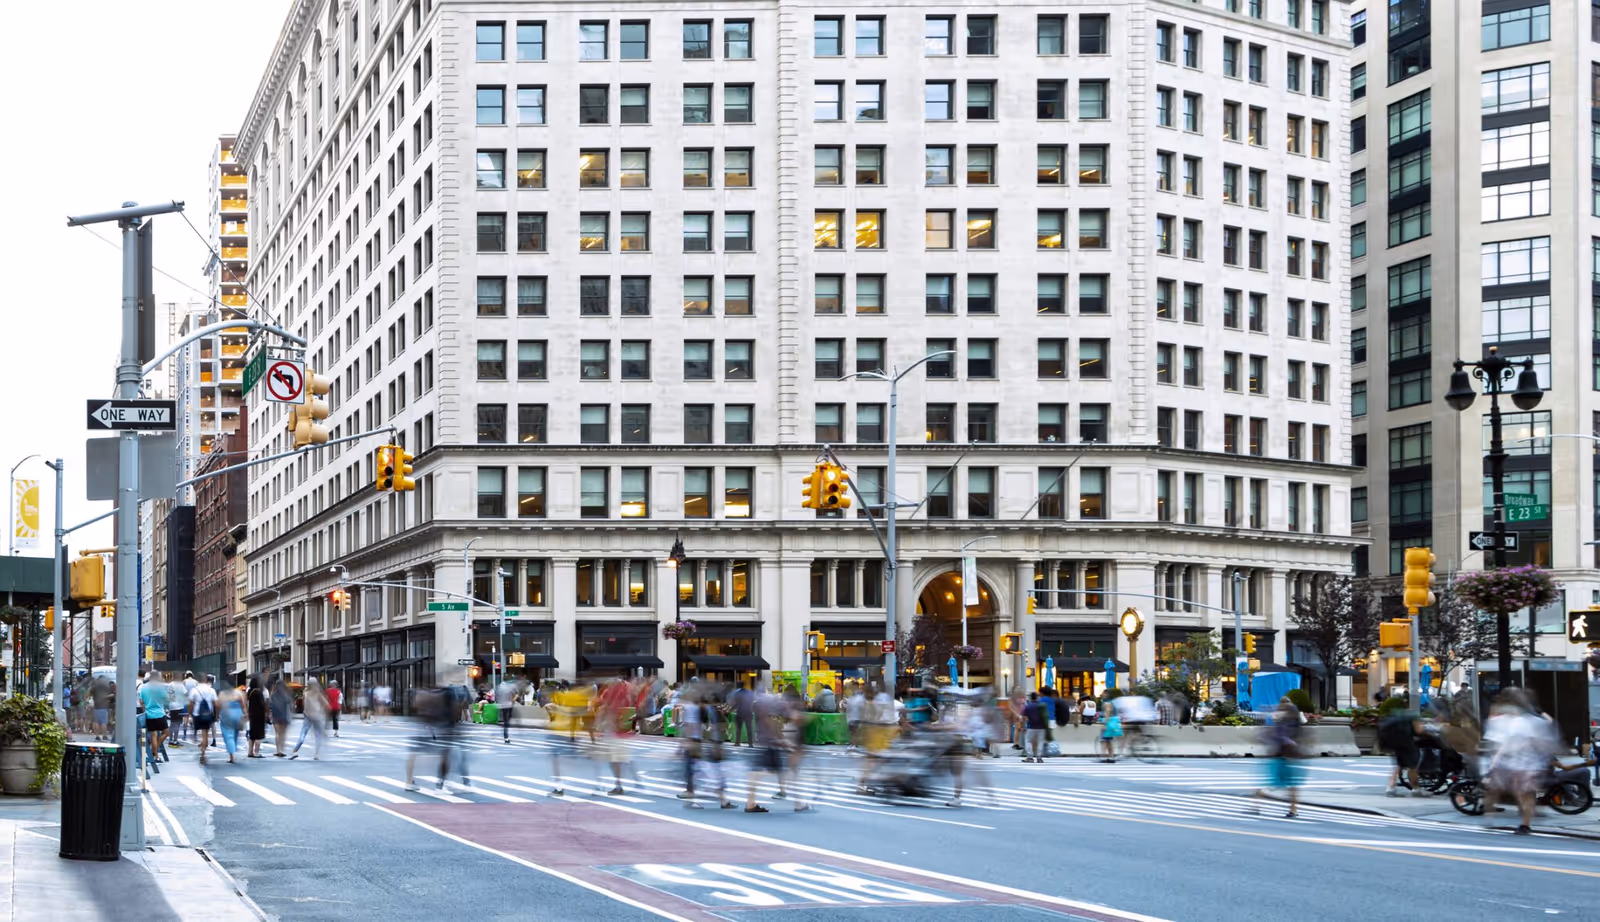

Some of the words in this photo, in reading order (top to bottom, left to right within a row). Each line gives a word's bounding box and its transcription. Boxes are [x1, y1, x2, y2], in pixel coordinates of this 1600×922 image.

[100, 409, 126, 421] ONE
[138, 409, 164, 421] WAY
[1504, 494, 1534, 506] Broadway
[1509, 508, 1514, 520] E
[1519, 507, 1530, 519] 23
[1476, 537, 1491, 545] ONE
[633, 862, 961, 905] BUS
